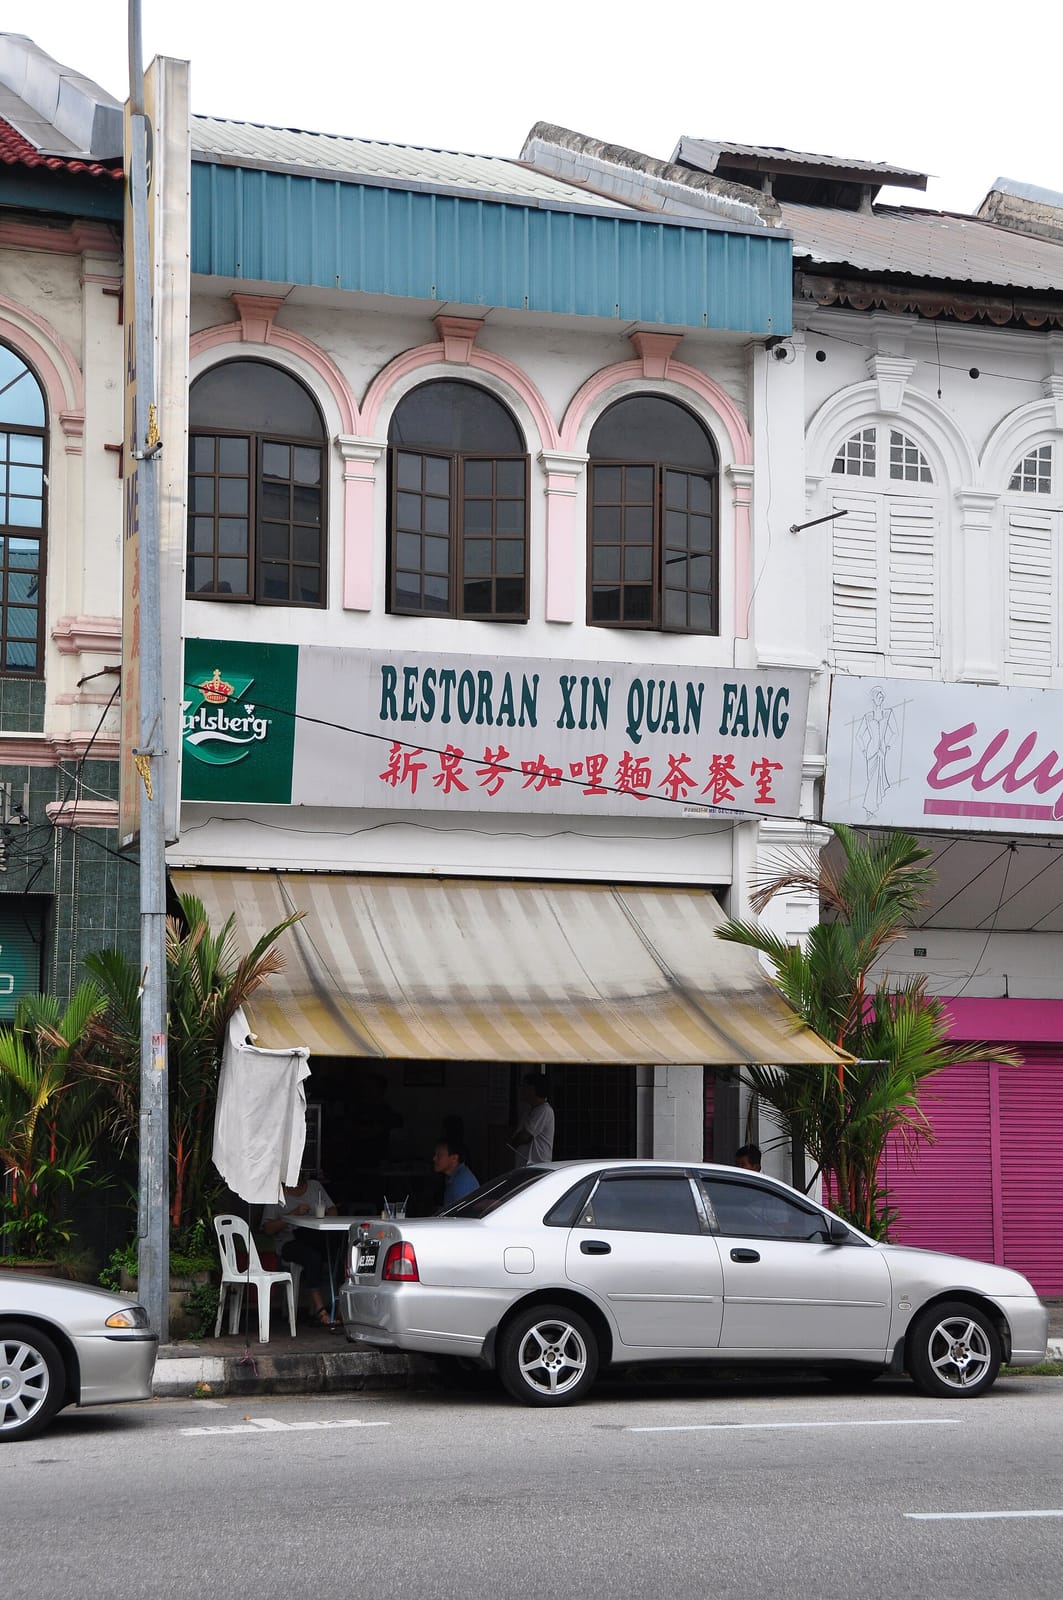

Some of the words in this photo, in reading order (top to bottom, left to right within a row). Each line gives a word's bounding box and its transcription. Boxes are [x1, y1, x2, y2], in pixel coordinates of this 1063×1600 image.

[182, 703, 268, 740] rlsberg
[379, 665, 540, 728] RESTORAN
[556, 675, 611, 730] XIN
[625, 678, 705, 744] QUAN
[718, 683, 790, 739] FANG
